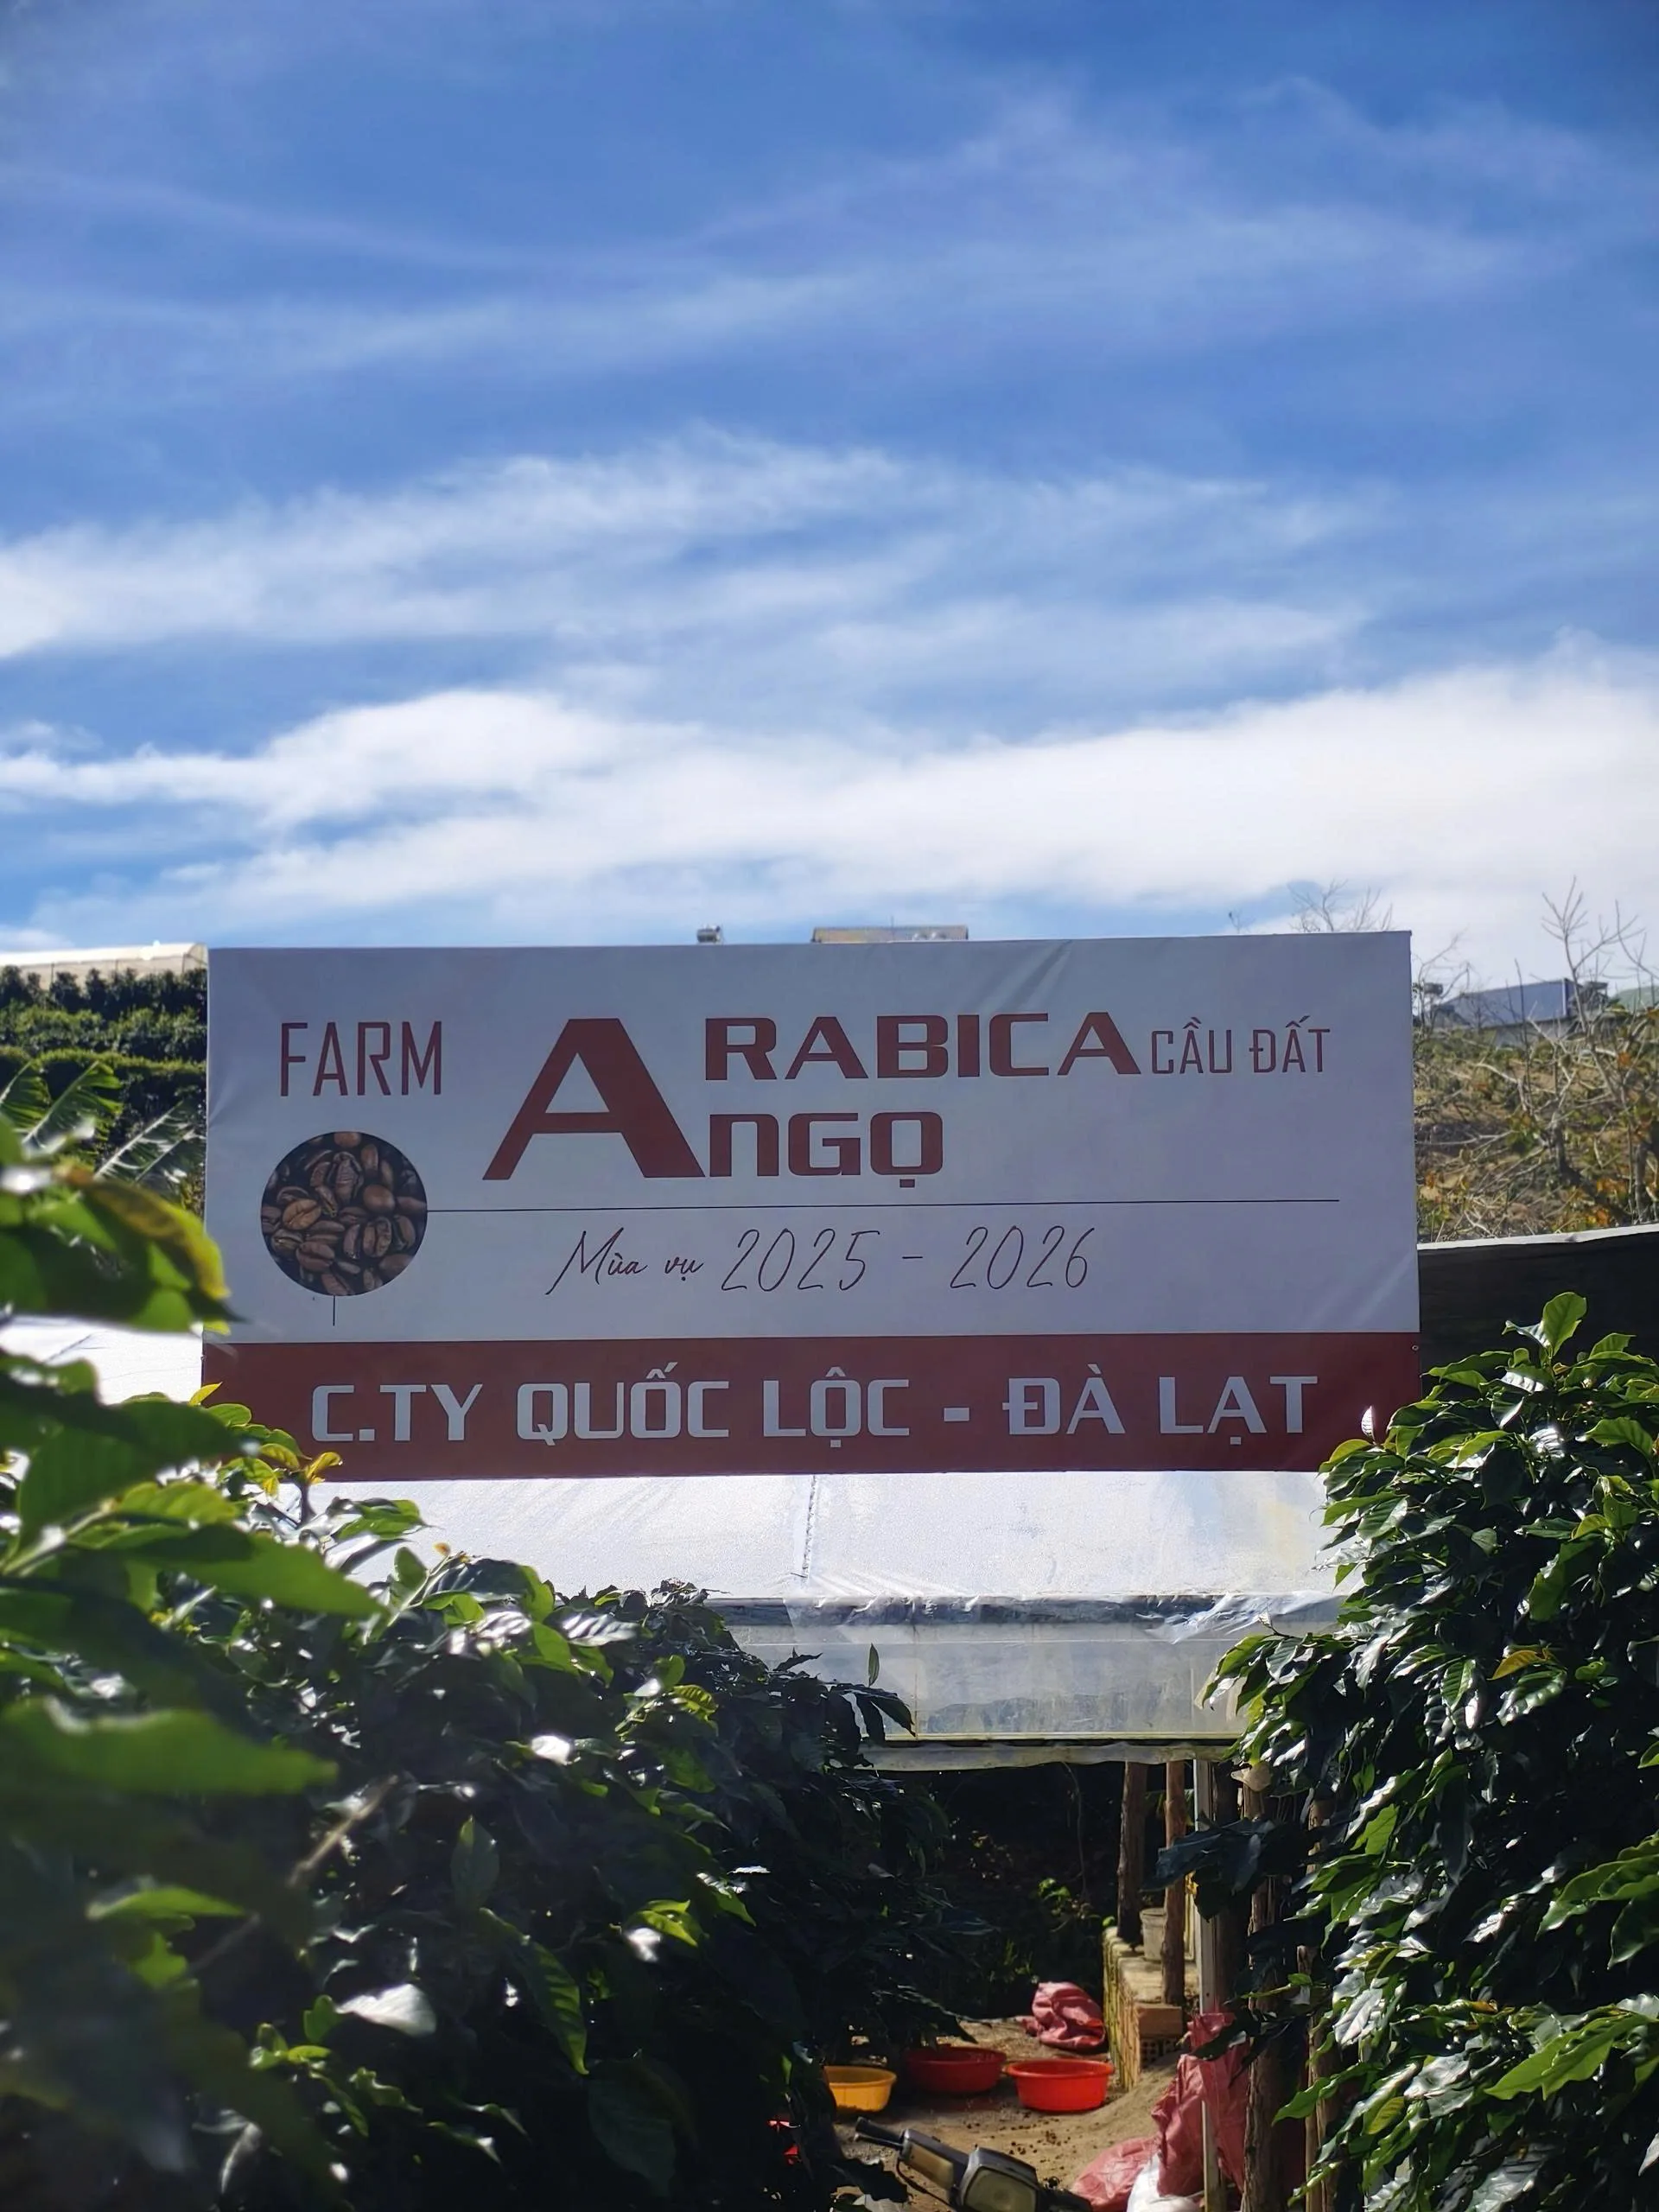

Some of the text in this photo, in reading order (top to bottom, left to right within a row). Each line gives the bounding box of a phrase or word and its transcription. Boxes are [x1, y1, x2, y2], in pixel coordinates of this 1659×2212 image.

[279, 1020, 443, 1096] FARM
[1150, 1015, 1233, 1075] CẦU
[1249, 1014, 1332, 1074] ĐẤT
[544, 1227, 648, 1295] Mùa
[664, 1260, 705, 1284] vụ
[720, 1228, 880, 1291] 2025
[950, 1224, 1096, 1289] 2026
[311, 1383, 483, 1443] C.TY
[517, 1361, 730, 1446] QUỐC
[761, 1366, 910, 1448] LỘC
[1001, 1363, 1126, 1435] ĐÀ
[1158, 1376, 1319, 1445] LẠT
